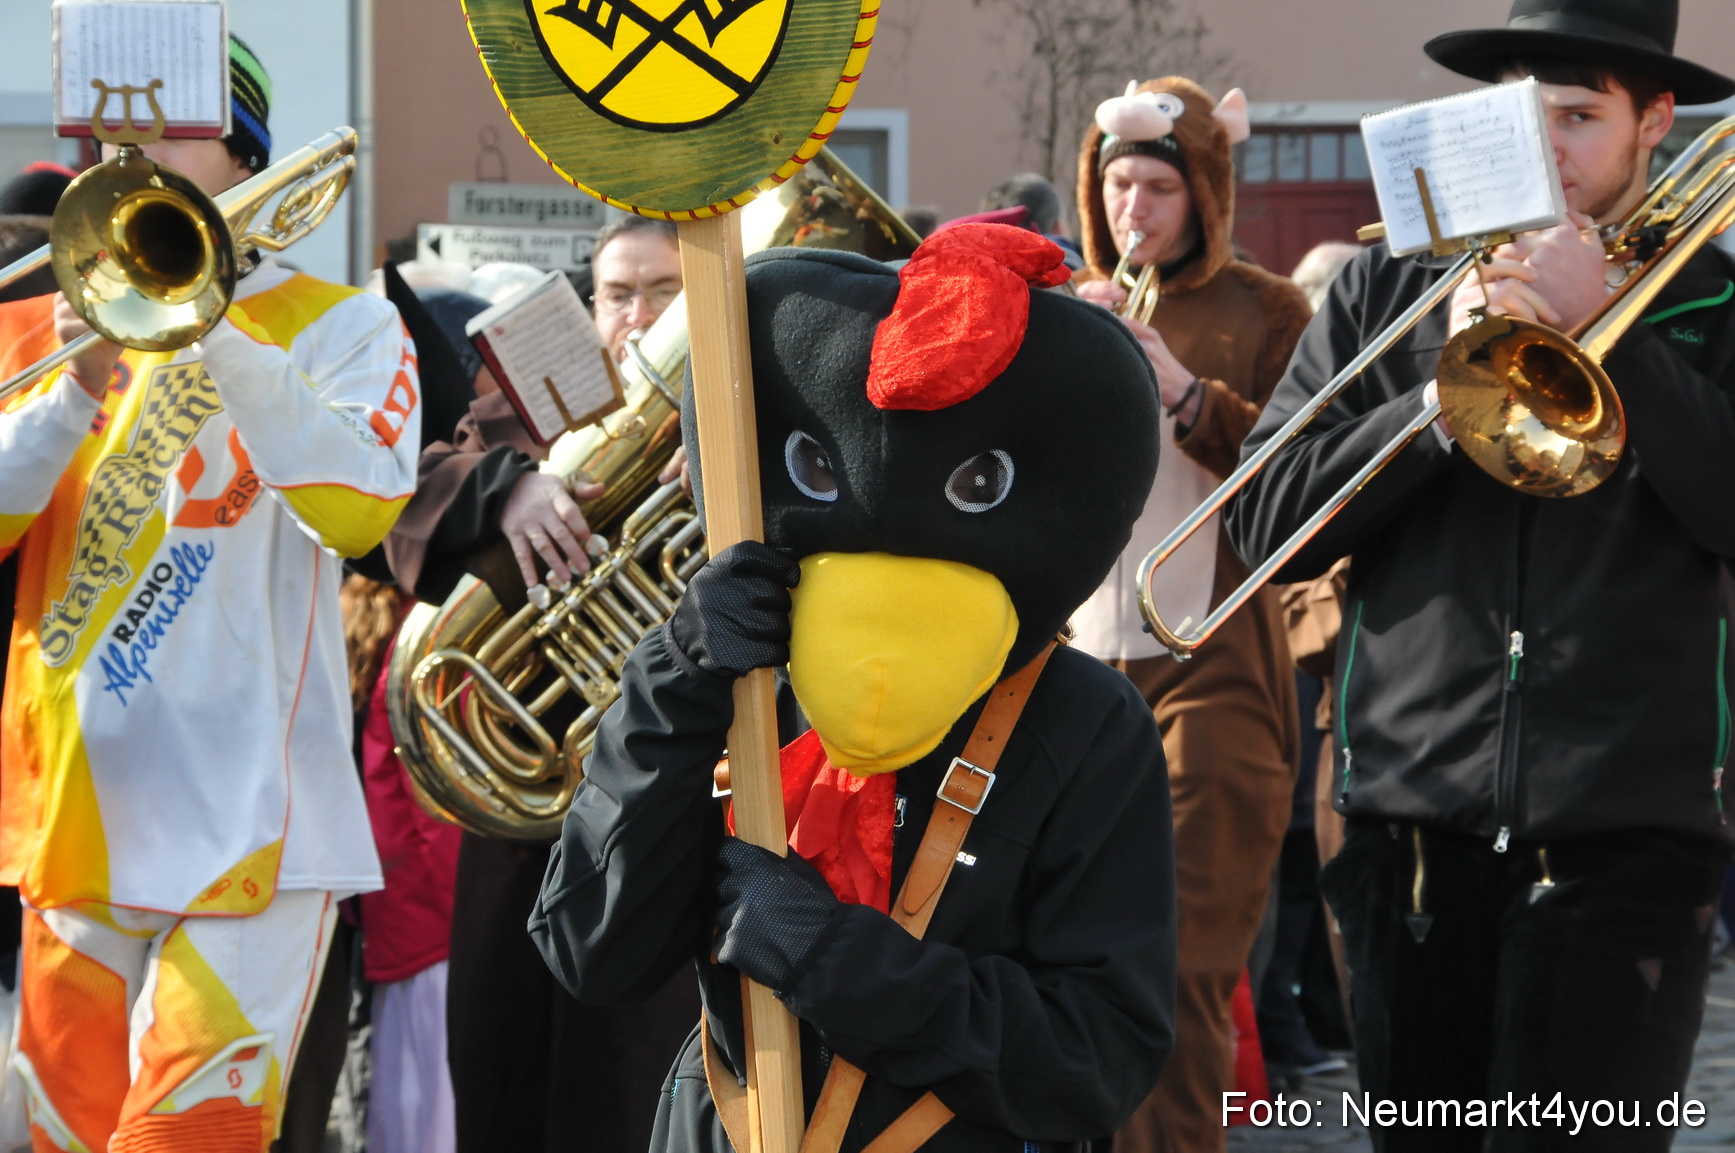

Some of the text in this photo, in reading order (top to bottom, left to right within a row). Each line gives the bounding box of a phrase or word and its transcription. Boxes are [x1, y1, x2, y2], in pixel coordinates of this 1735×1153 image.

[41, 550, 124, 660] Stag
[99, 539, 215, 708] Alpenwelle
[112, 562, 173, 645] RADIO
